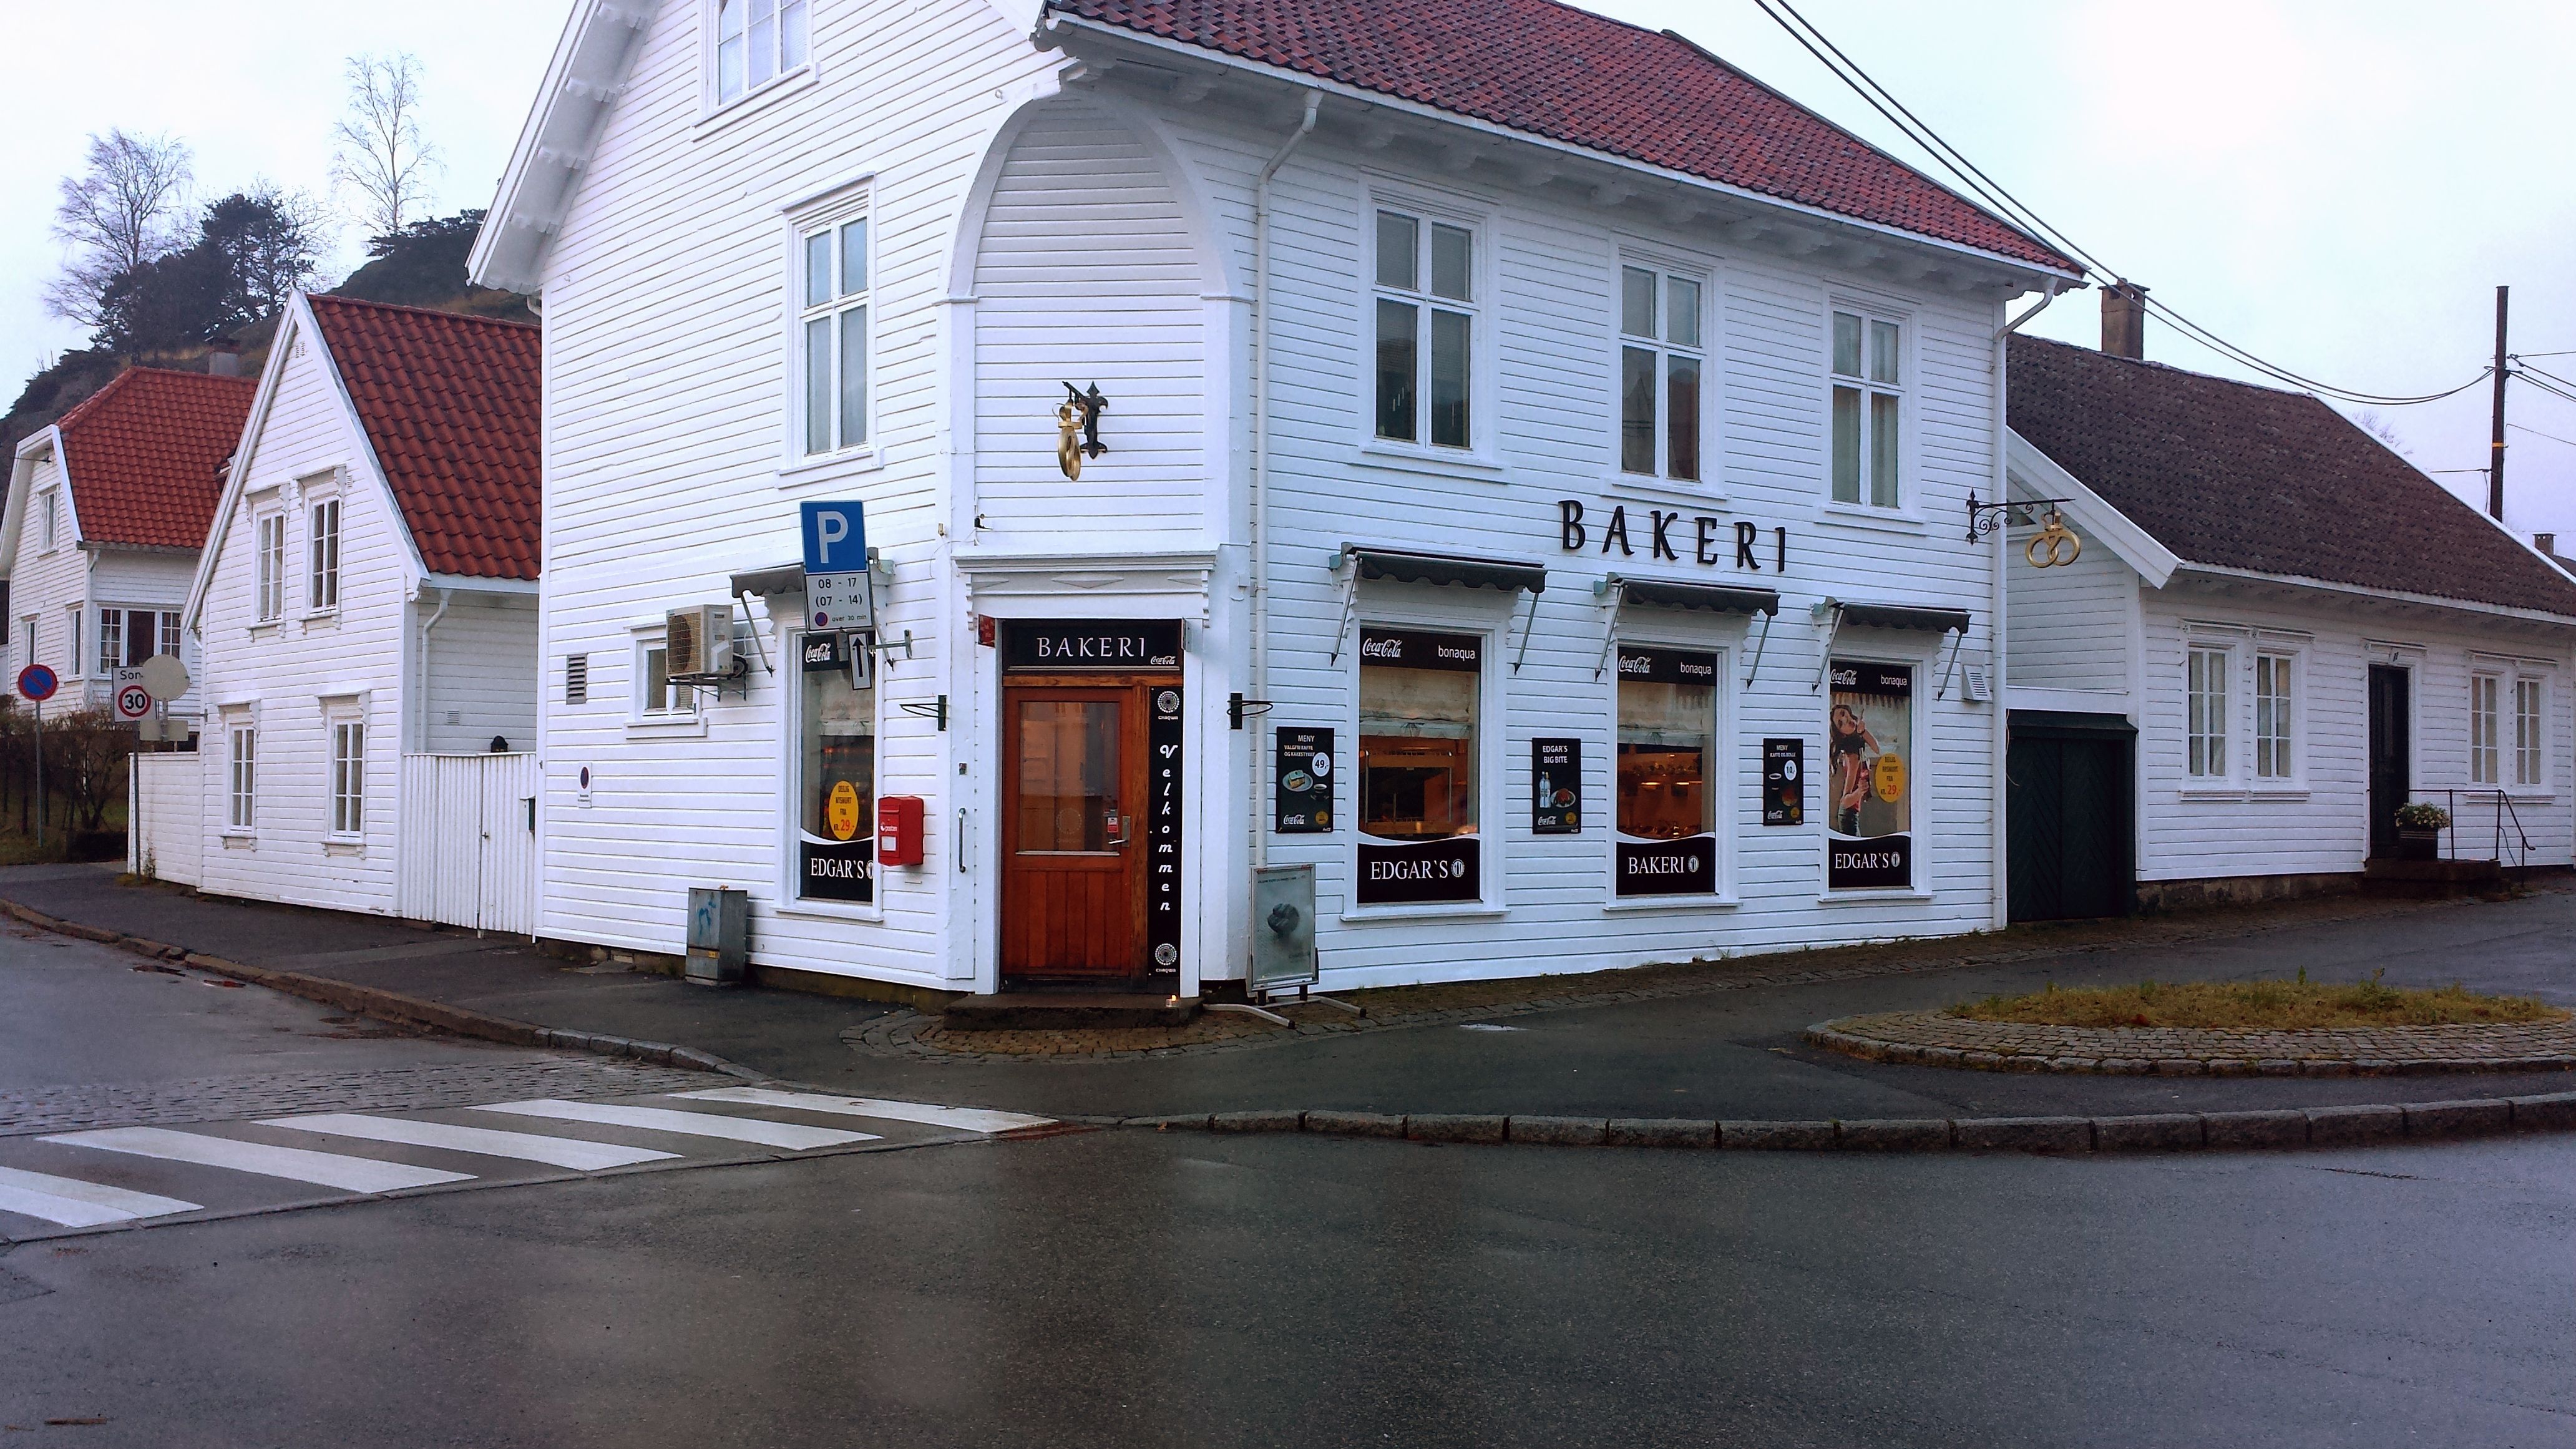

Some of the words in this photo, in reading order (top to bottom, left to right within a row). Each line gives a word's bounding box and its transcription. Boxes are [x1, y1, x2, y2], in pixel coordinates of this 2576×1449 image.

[817, 510, 849, 564] P
[1558, 499, 1786, 573] BAKERI
[818, 578, 832, 589] 08
[847, 577, 857, 588] 17
[816, 596, 832, 608] (07
[849, 593, 862, 605] 14)
[1037, 637, 1144, 657] BAKERI
[1362, 638, 1403, 658] Coca-Cola
[1438, 645, 1476, 661] bonaqua
[1680, 661, 1712, 676] bonaqua
[1880, 674, 1908, 688] bonaqua
[125, 693, 145, 710] 30
[1298, 734, 1315, 743] MENY
[1315, 759, 1329, 769] 49,-
[1158, 744, 1178, 911] Velkommen
[1627, 856, 1685, 874] BAKERI
